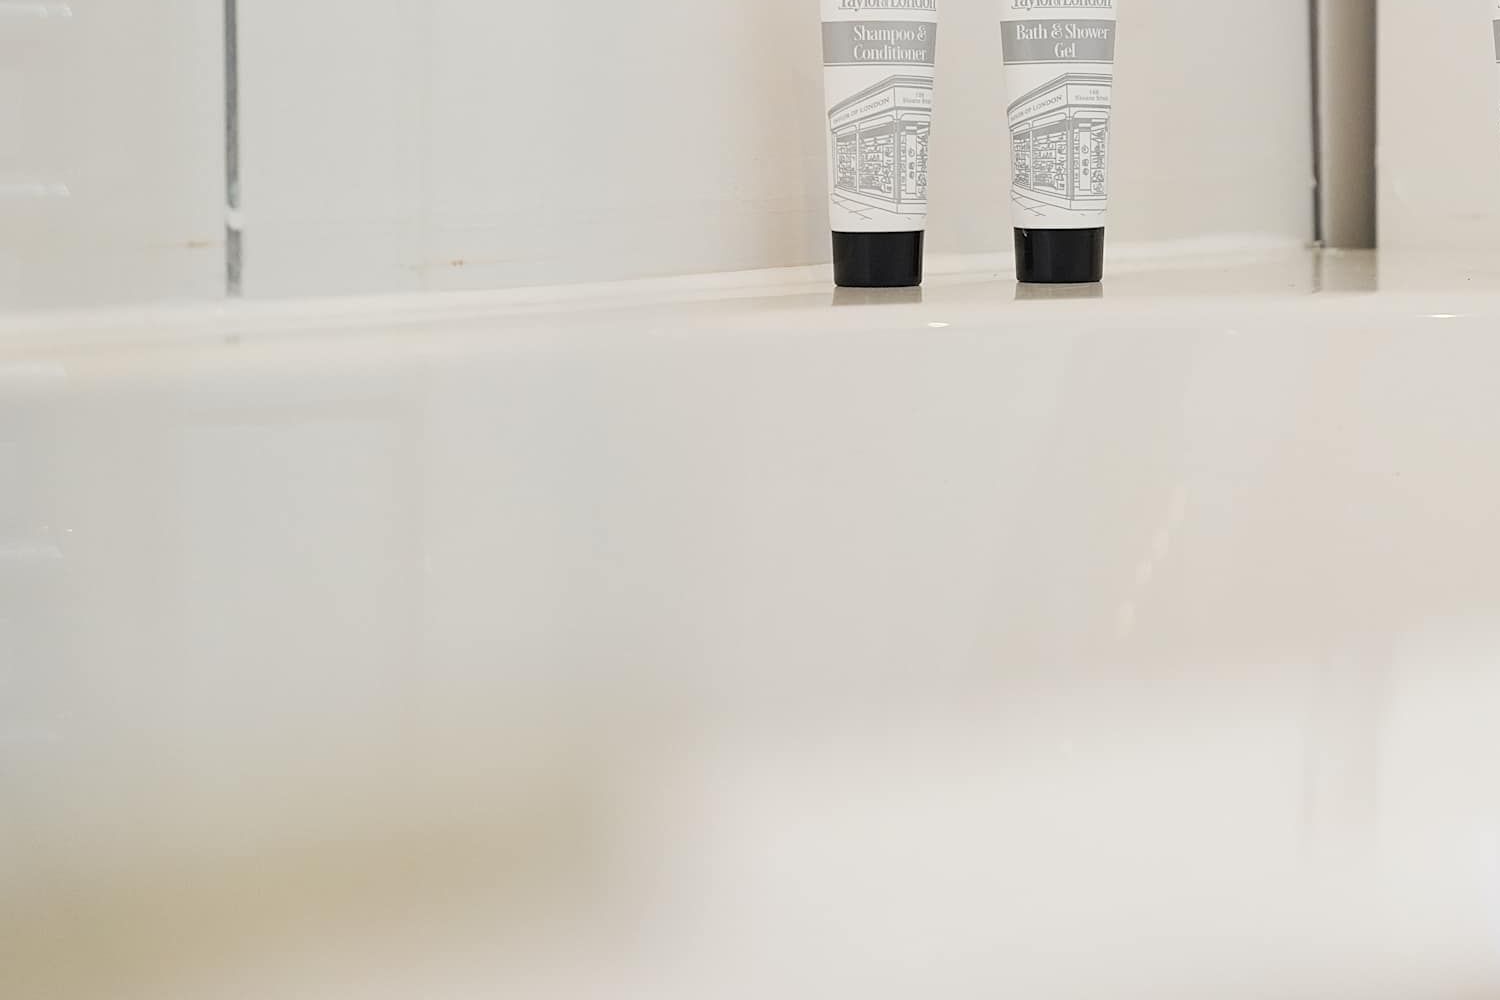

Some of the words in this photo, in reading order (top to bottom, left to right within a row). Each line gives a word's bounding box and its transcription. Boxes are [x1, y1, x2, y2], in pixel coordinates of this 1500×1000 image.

[853, 24, 915, 45] Shampoo
[917, 25, 927, 41] &
[1016, 23, 1047, 40] Bath
[1051, 23, 1062, 39] &
[1065, 23, 1110, 39] Shower
[853, 45, 927, 61] Conditioner
[1054, 42, 1076, 58] Gel
